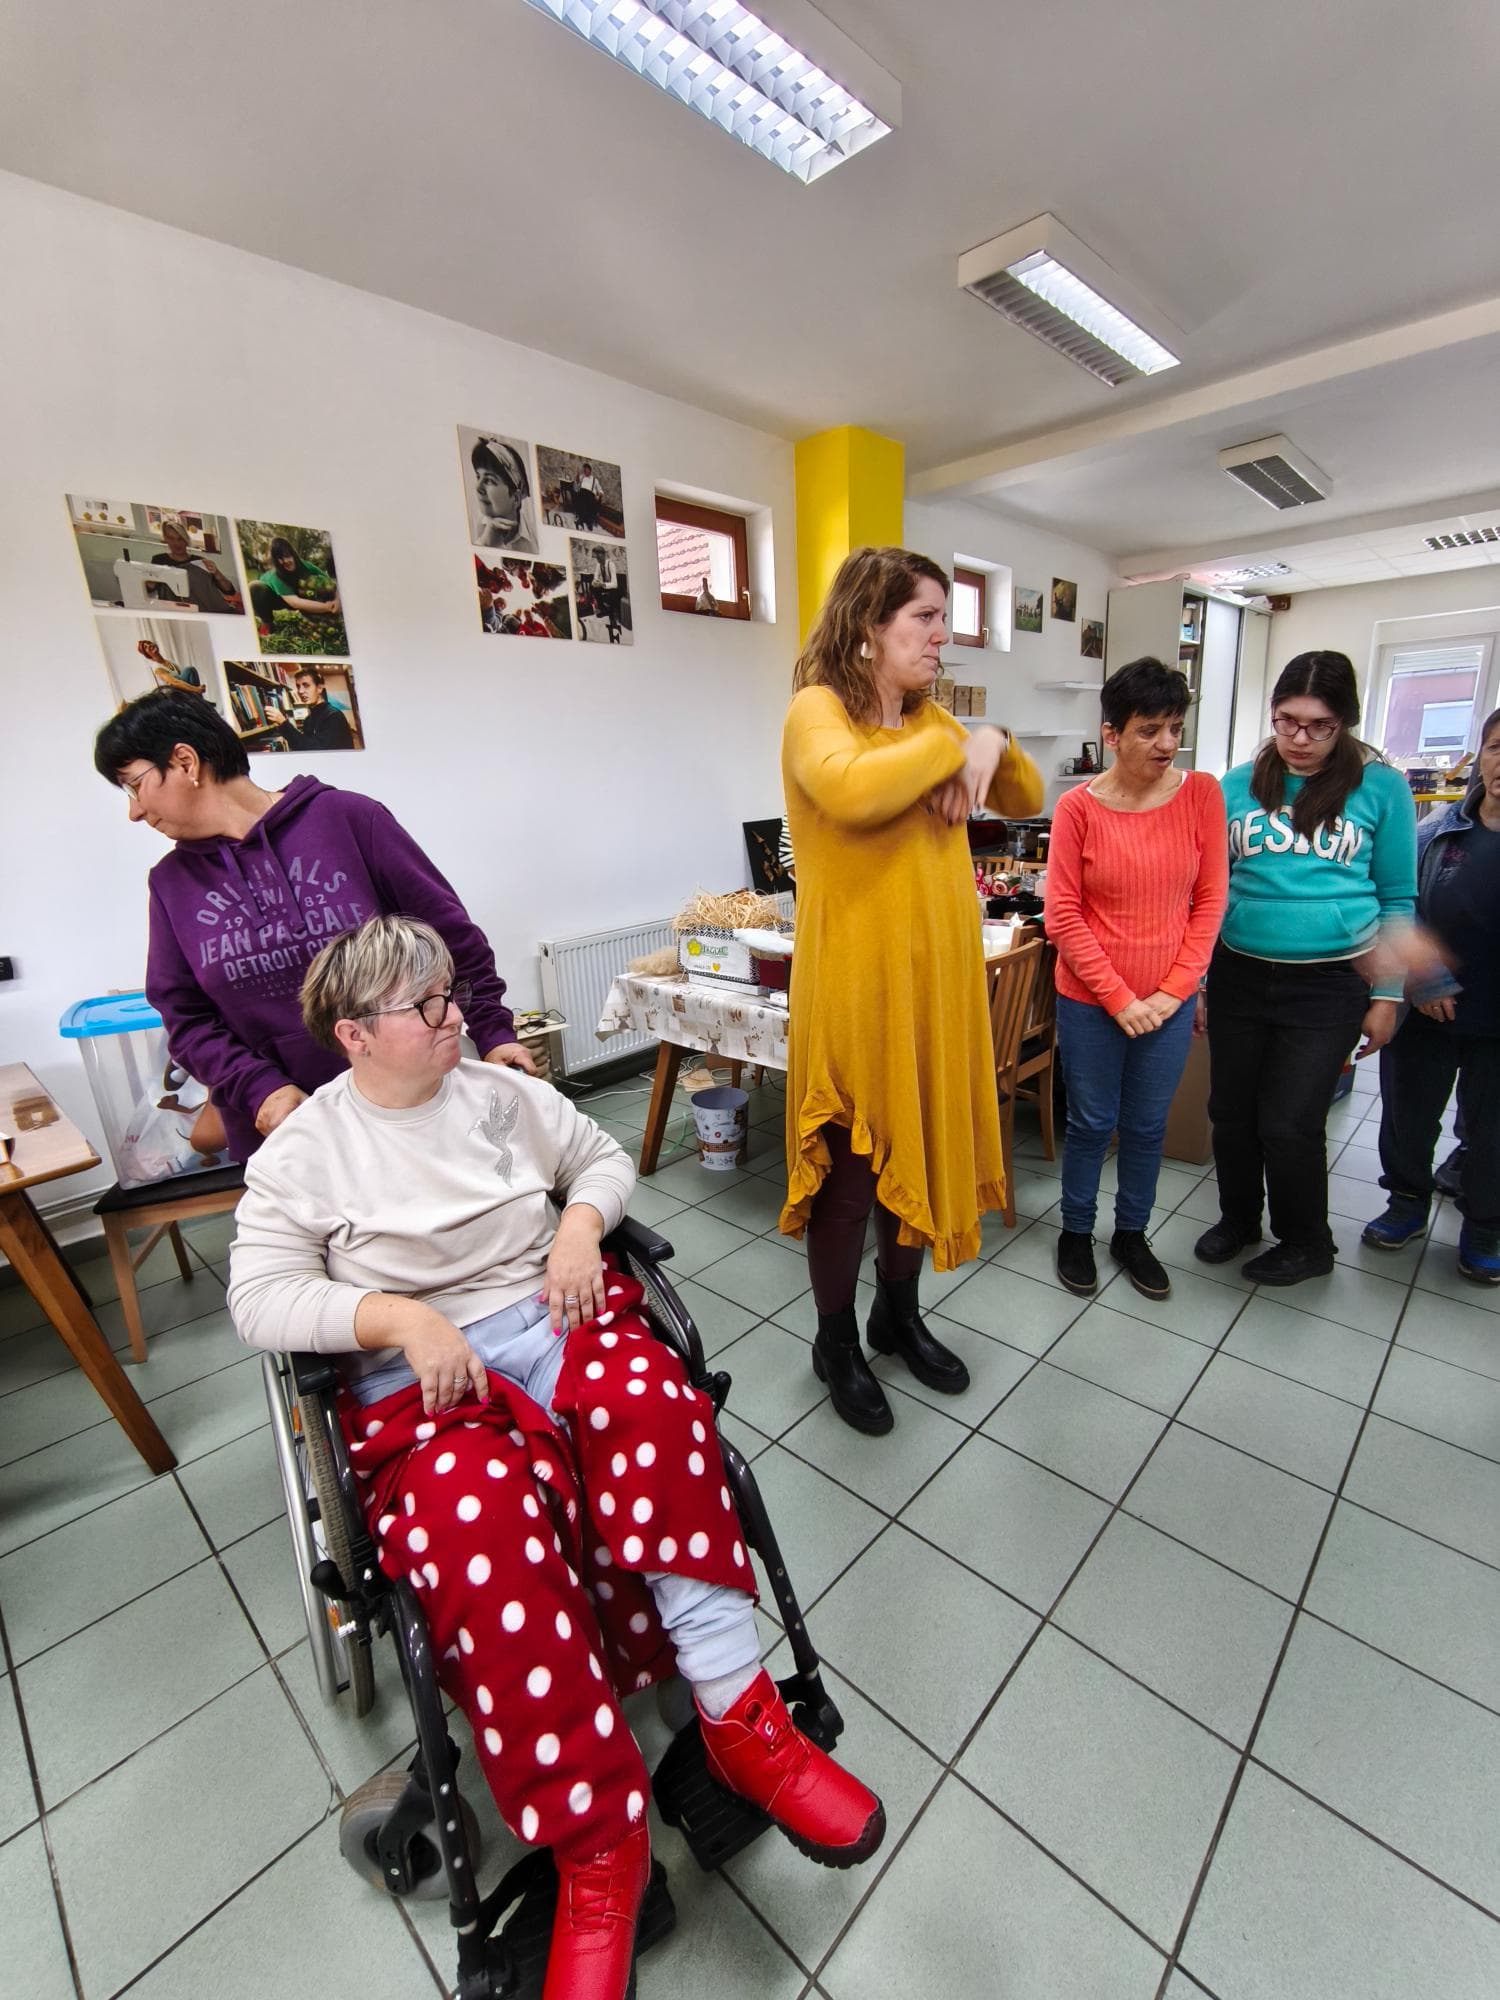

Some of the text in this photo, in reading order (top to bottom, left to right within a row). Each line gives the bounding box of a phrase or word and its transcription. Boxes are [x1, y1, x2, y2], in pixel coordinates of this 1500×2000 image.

[224, 893, 327, 931] 19 82
[200, 926, 254, 969] JEAN
[223, 944, 302, 982] DETROIT
